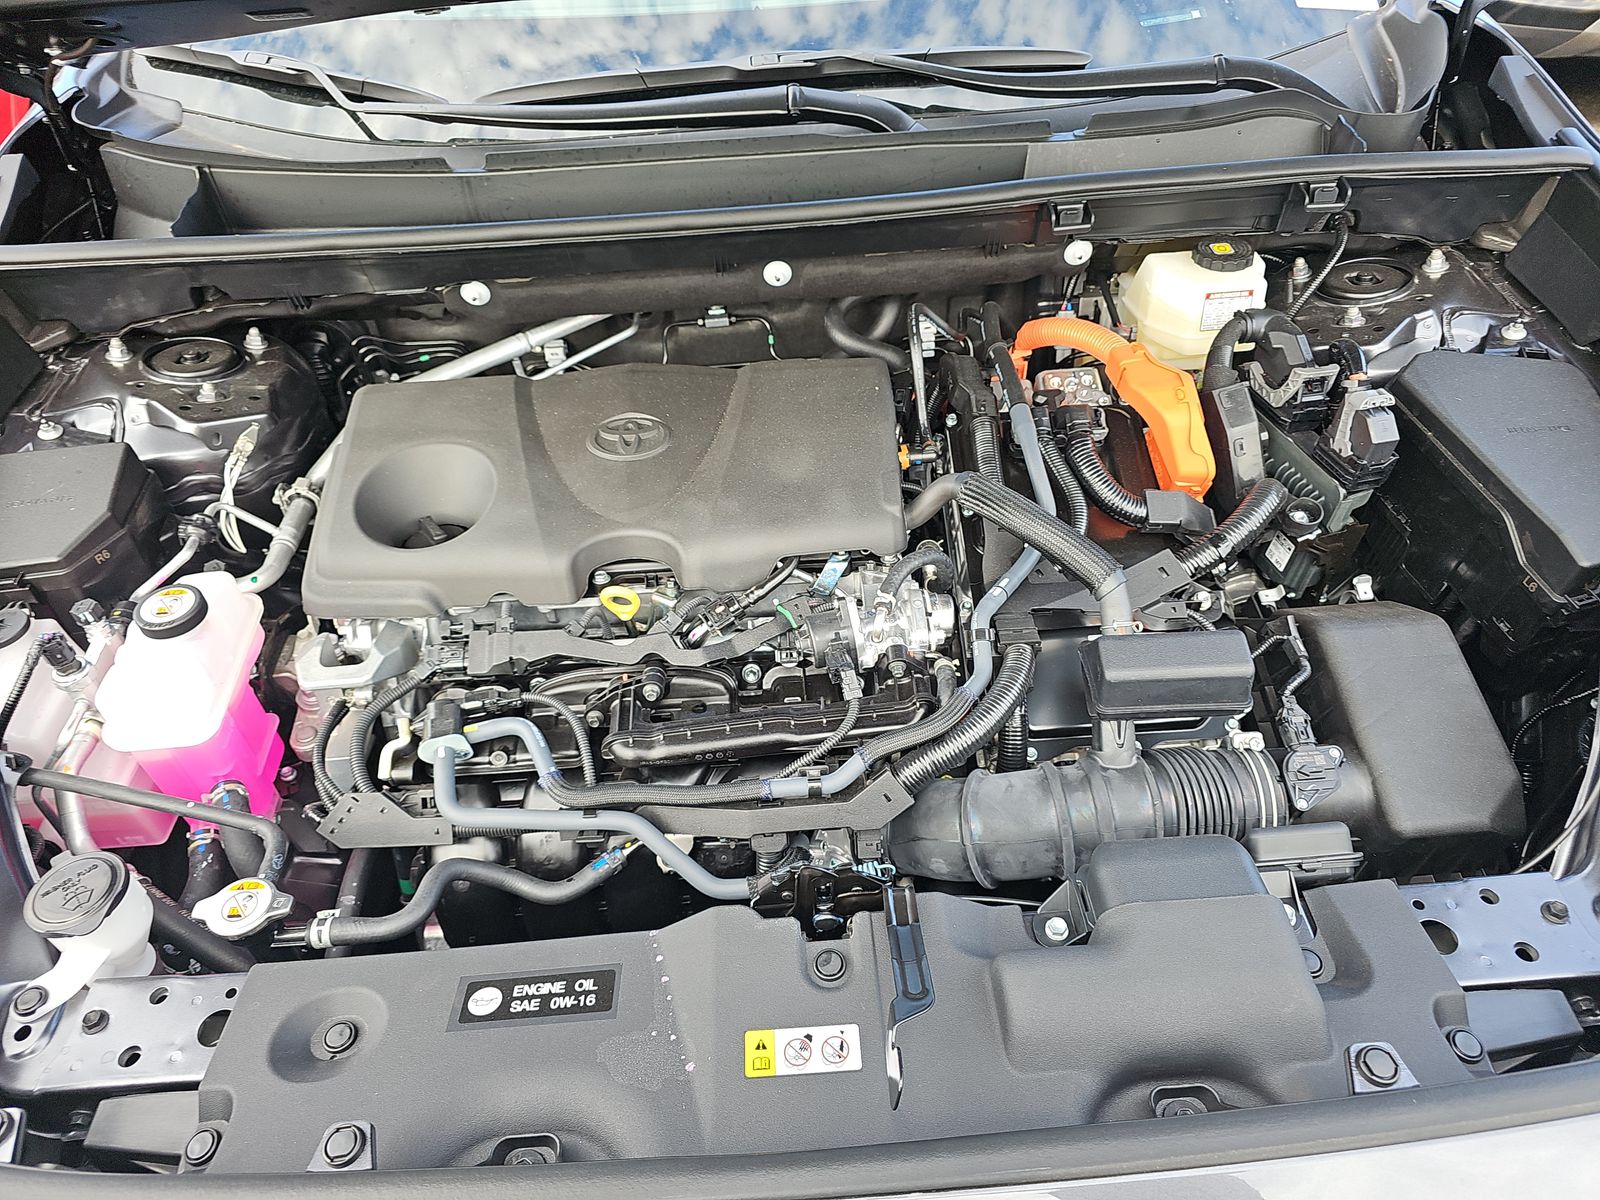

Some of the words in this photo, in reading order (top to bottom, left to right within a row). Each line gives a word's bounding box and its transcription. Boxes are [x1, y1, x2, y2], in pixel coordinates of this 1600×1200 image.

[94, 549, 111, 564] R6
[1522, 575, 1538, 593] L6
[512, 980, 567, 997] ENGINE
[574, 978, 599, 992] OIL
[509, 998, 541, 1013] SAE
[550, 993, 597, 1010] 0W-16
